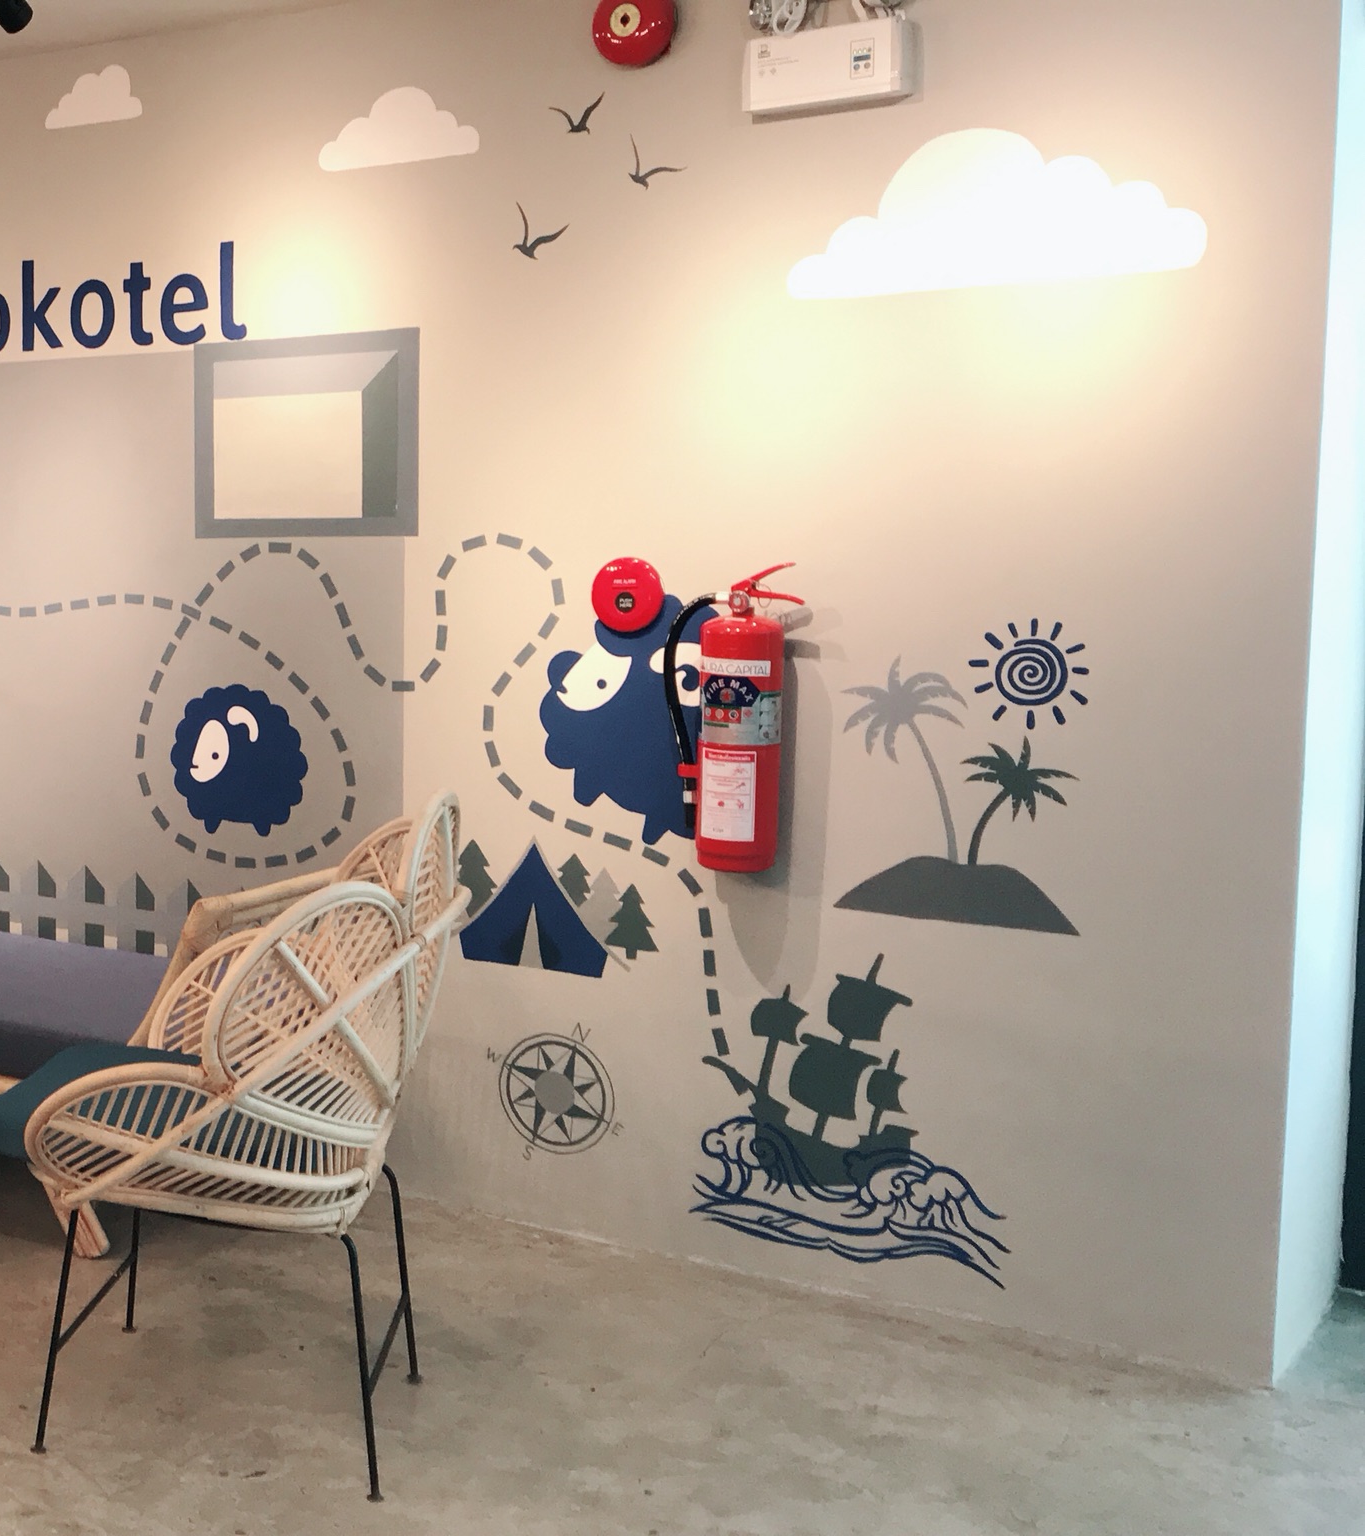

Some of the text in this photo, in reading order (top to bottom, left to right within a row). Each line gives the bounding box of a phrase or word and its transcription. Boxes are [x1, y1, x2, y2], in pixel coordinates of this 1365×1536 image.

[725, 663, 770, 675] CAPITAL
[705, 678, 754, 703] FIRE MAX
[571, 1021, 591, 1043] N
